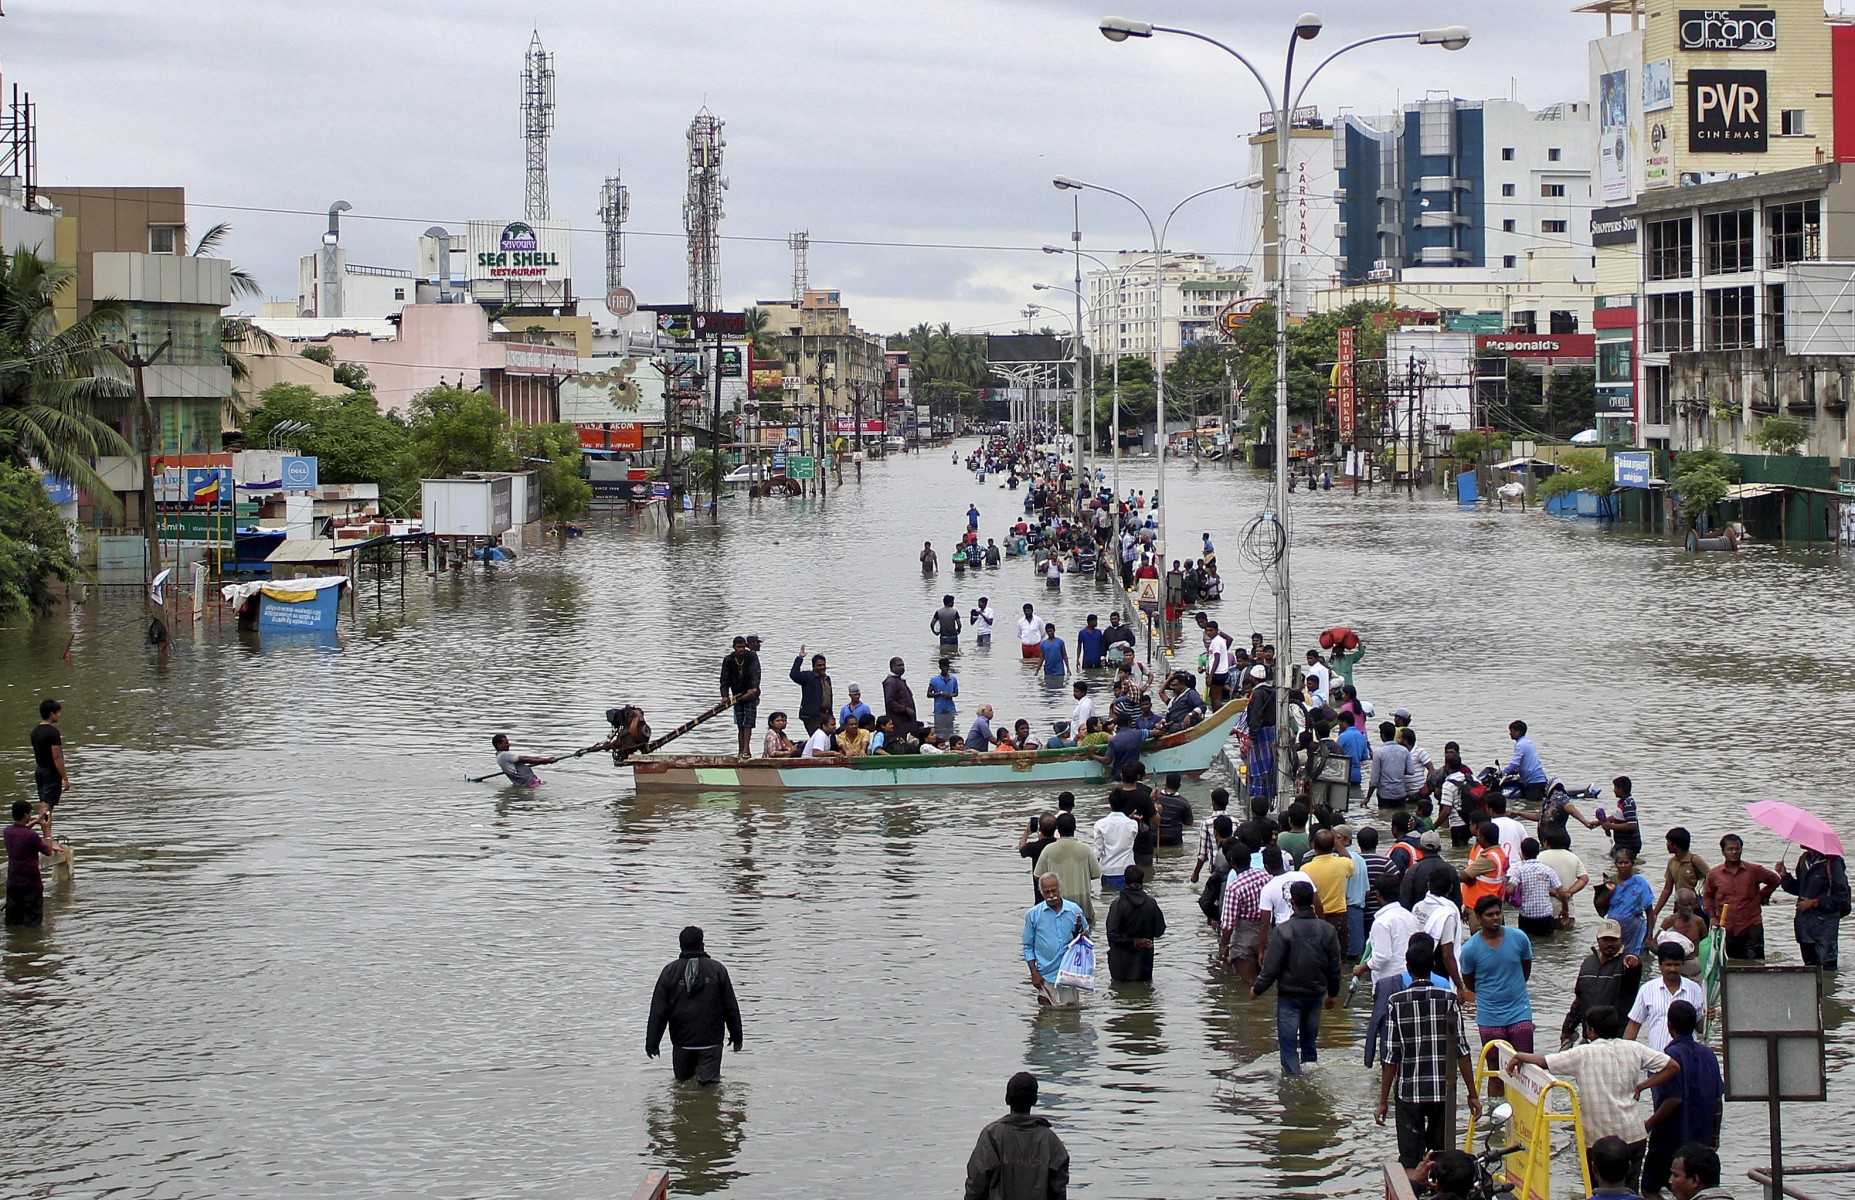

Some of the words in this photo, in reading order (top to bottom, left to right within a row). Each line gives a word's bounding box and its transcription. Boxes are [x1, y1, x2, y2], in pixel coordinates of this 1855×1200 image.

[1704, 10, 1730, 20] the
[1681, 19, 1776, 48] grand
[1705, 38, 1738, 48] mall
[1697, 83, 1760, 129] PVR
[1697, 130, 1760, 139] CINEMAS
[1299, 162, 1307, 254] SARAVANA
[1591, 220, 1622, 234] SHOPPERS
[1623, 217, 1637, 230] STO
[502, 241, 536, 249] SAVOURY
[478, 252, 507, 266] SEA
[512, 252, 559, 266] SHELL
[490, 268, 547, 277] RESTAURANT
[612, 295, 629, 309] FIAT
[1486, 340, 1560, 351] McDonald's
